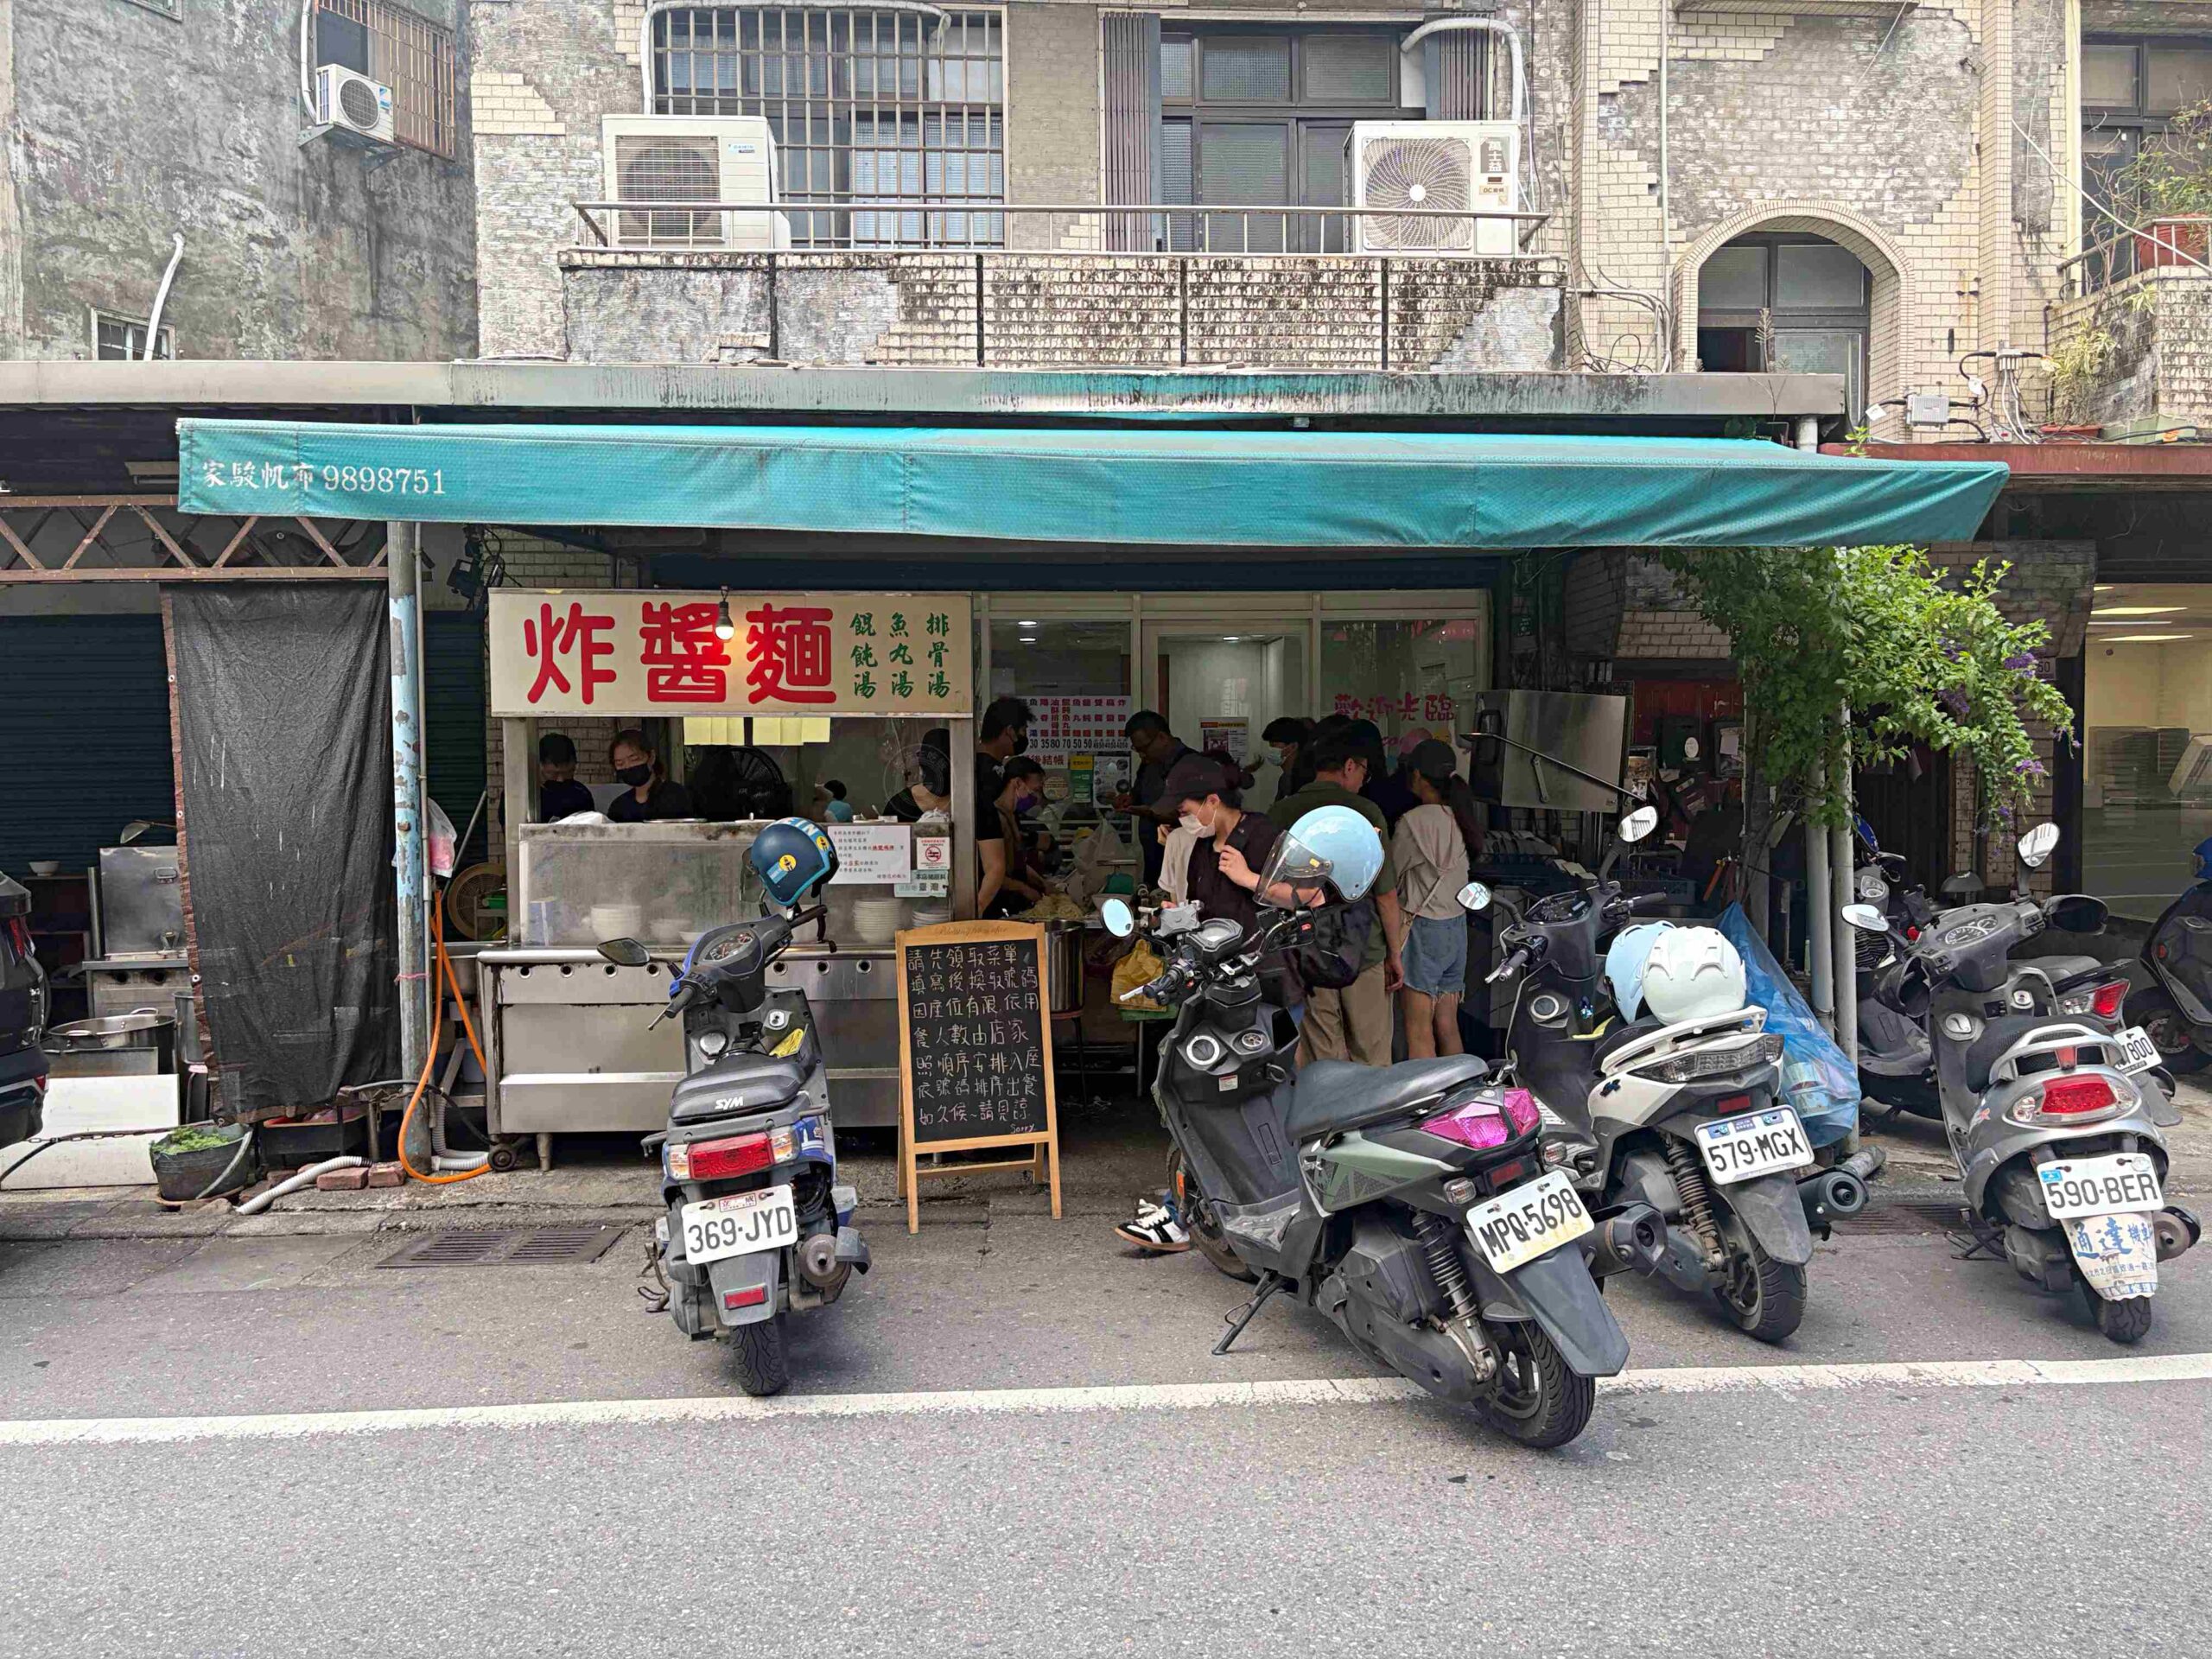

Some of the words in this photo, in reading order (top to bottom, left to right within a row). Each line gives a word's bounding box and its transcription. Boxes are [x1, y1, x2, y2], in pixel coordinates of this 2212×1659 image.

[322, 464, 446, 495] 9898751
[524, 601, 837, 706] 炸醬麵
[849, 612, 879, 699] 餛飩湯
[888, 612, 916, 699] 魚丸湯
[925, 612, 951, 699] 排骨湯
[1334, 692, 1457, 722] 歡迎光臨
[1029, 739, 1039, 748] 30
[1040, 739, 1050, 748] 35
[1050, 739, 1060, 748] 80
[1062, 739, 1071, 748] 70
[1072, 739, 1082, 748] 50
[1084, 739, 1092, 748] 50
[1027, 754, 1065, 766] 後結帳
[908, 944, 1017, 973] 請先領取菜單
[910, 966, 1038, 995] 填寫後換取號碼
[914, 1019, 1029, 1048] 餐人數由店家
[916, 1046, 1041, 1077] 照順序安排入座
[917, 1073, 1038, 1099] 依號碼排序出餐
[715, 1096, 744, 1110] SYM
